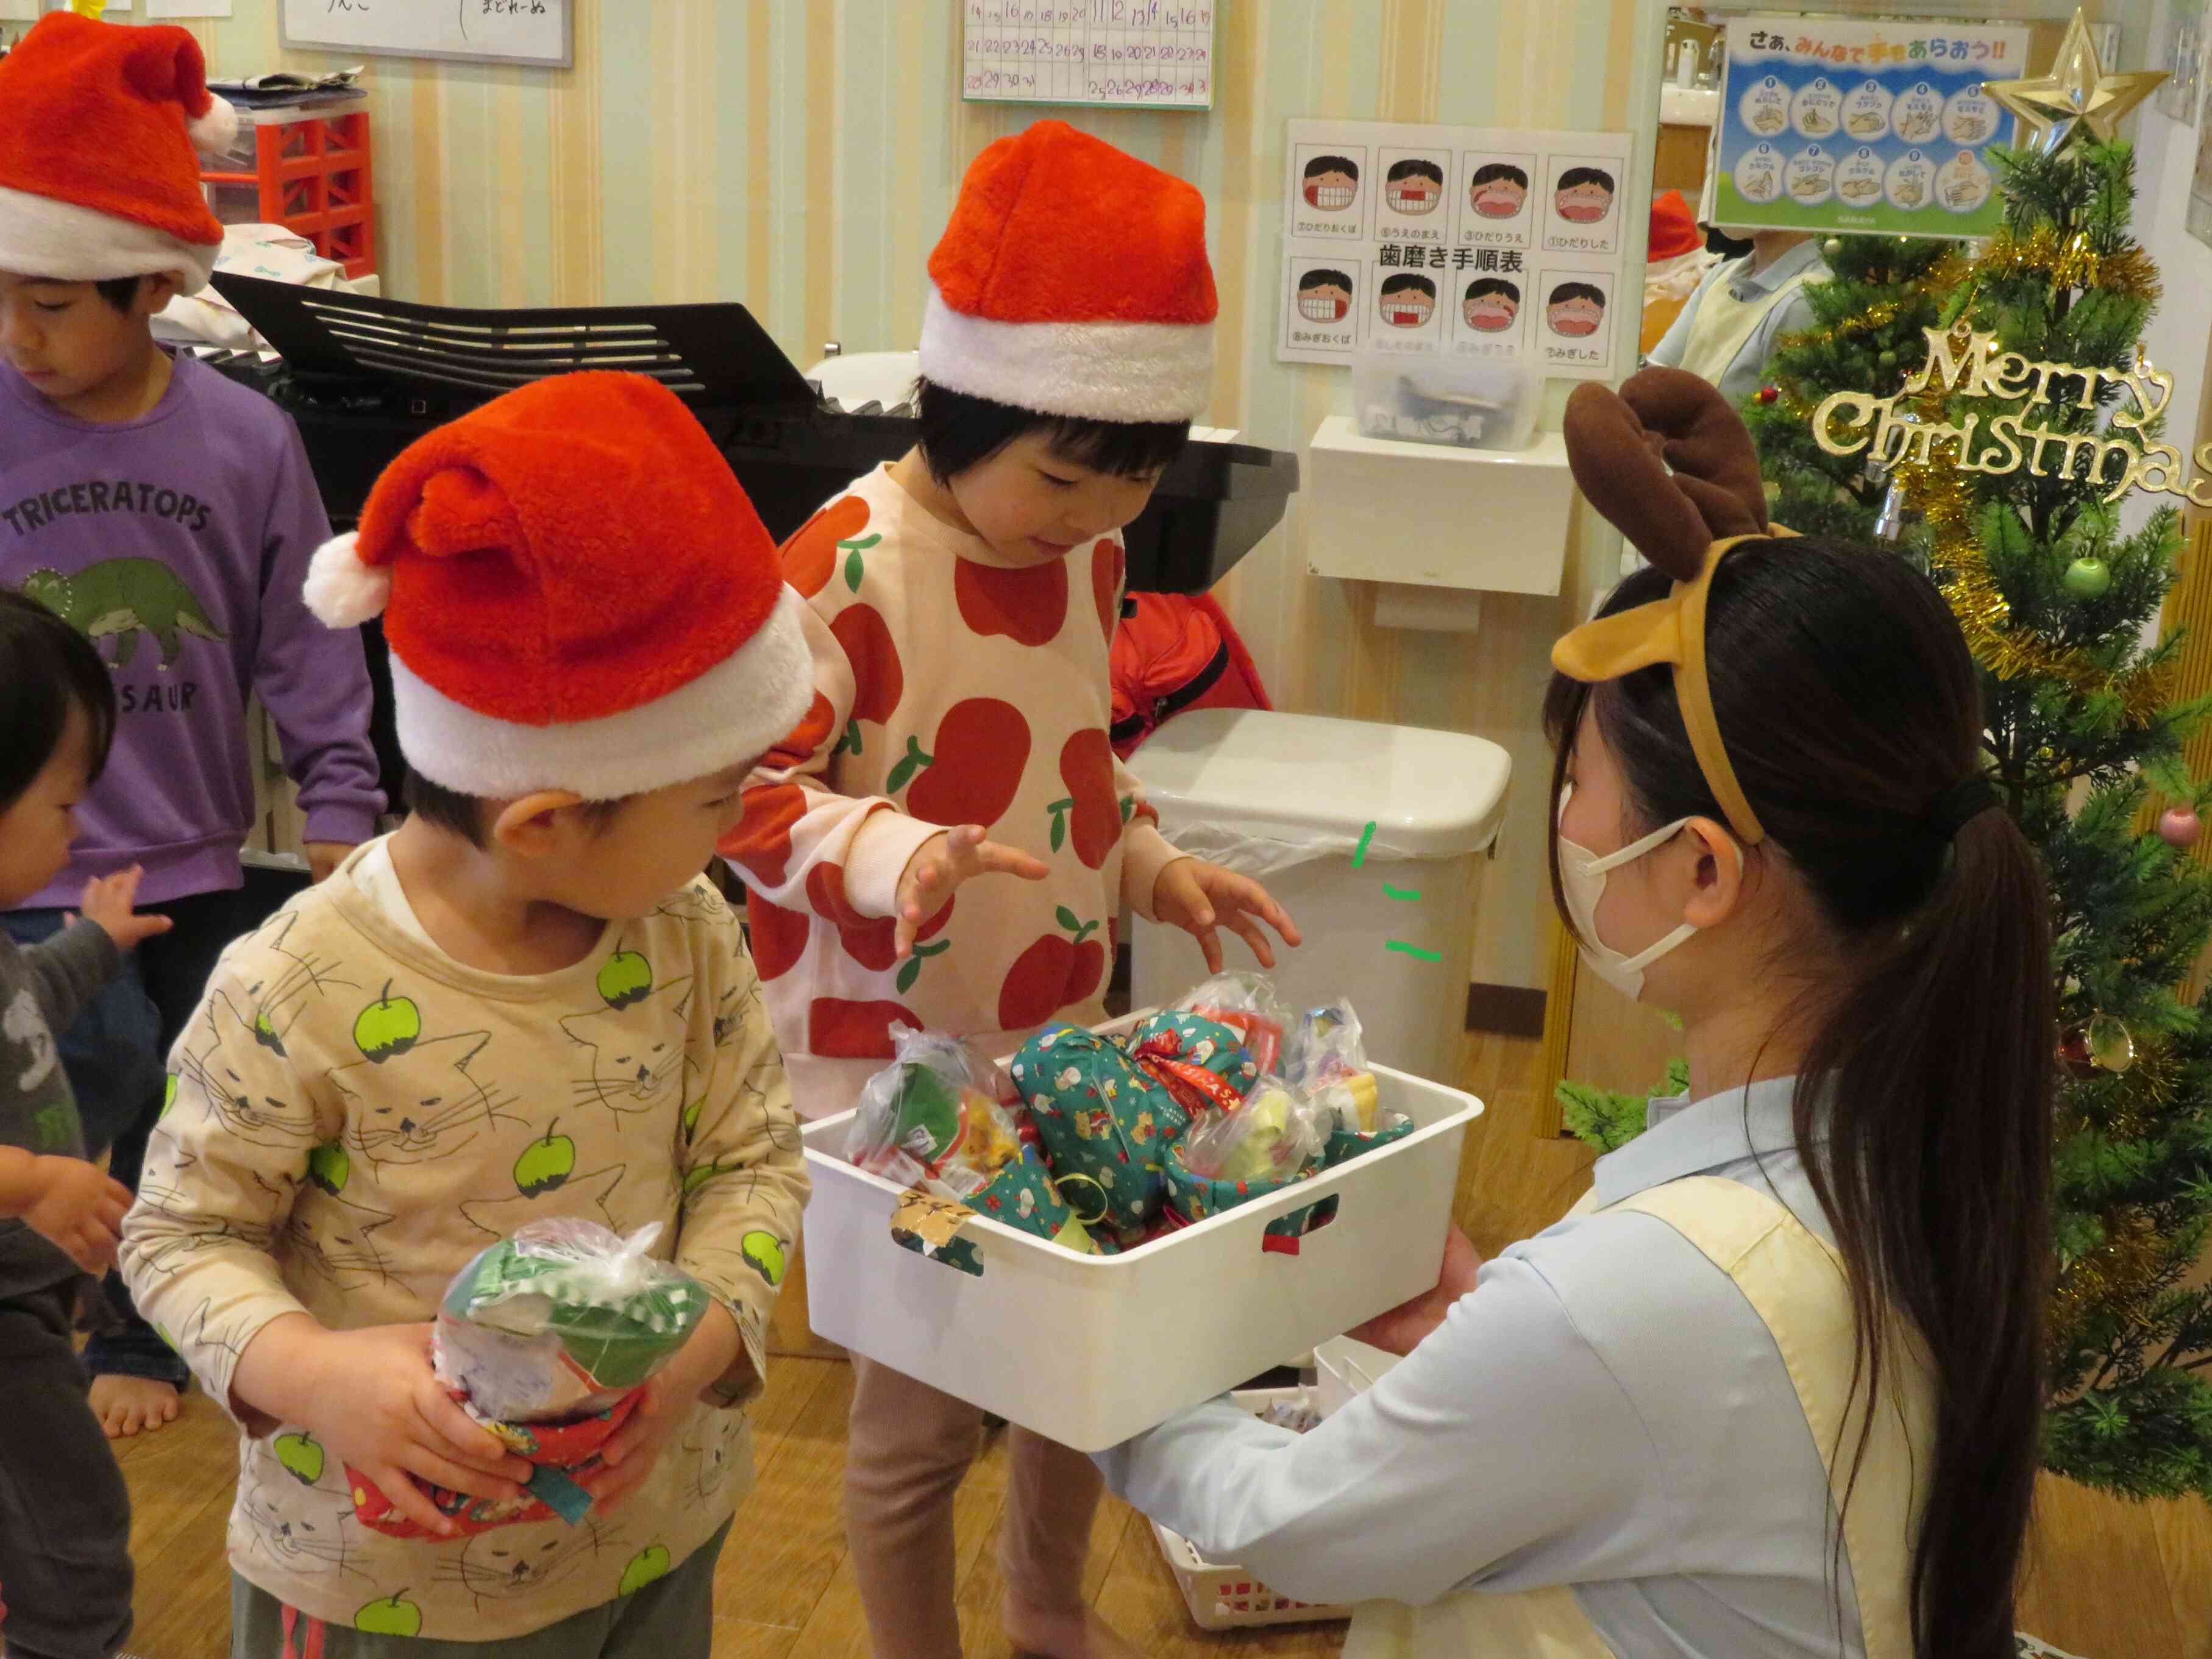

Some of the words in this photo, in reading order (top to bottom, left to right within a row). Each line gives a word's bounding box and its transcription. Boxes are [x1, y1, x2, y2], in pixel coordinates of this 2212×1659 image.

[1379, 244, 1523, 272] 歯磨き手順表
[1905, 326, 2174, 428] Merry
[1812, 391, 2212, 508] Christmas
[1, 481, 212, 536] TRICERATOPS
[122, 682, 198, 712] SAUR
